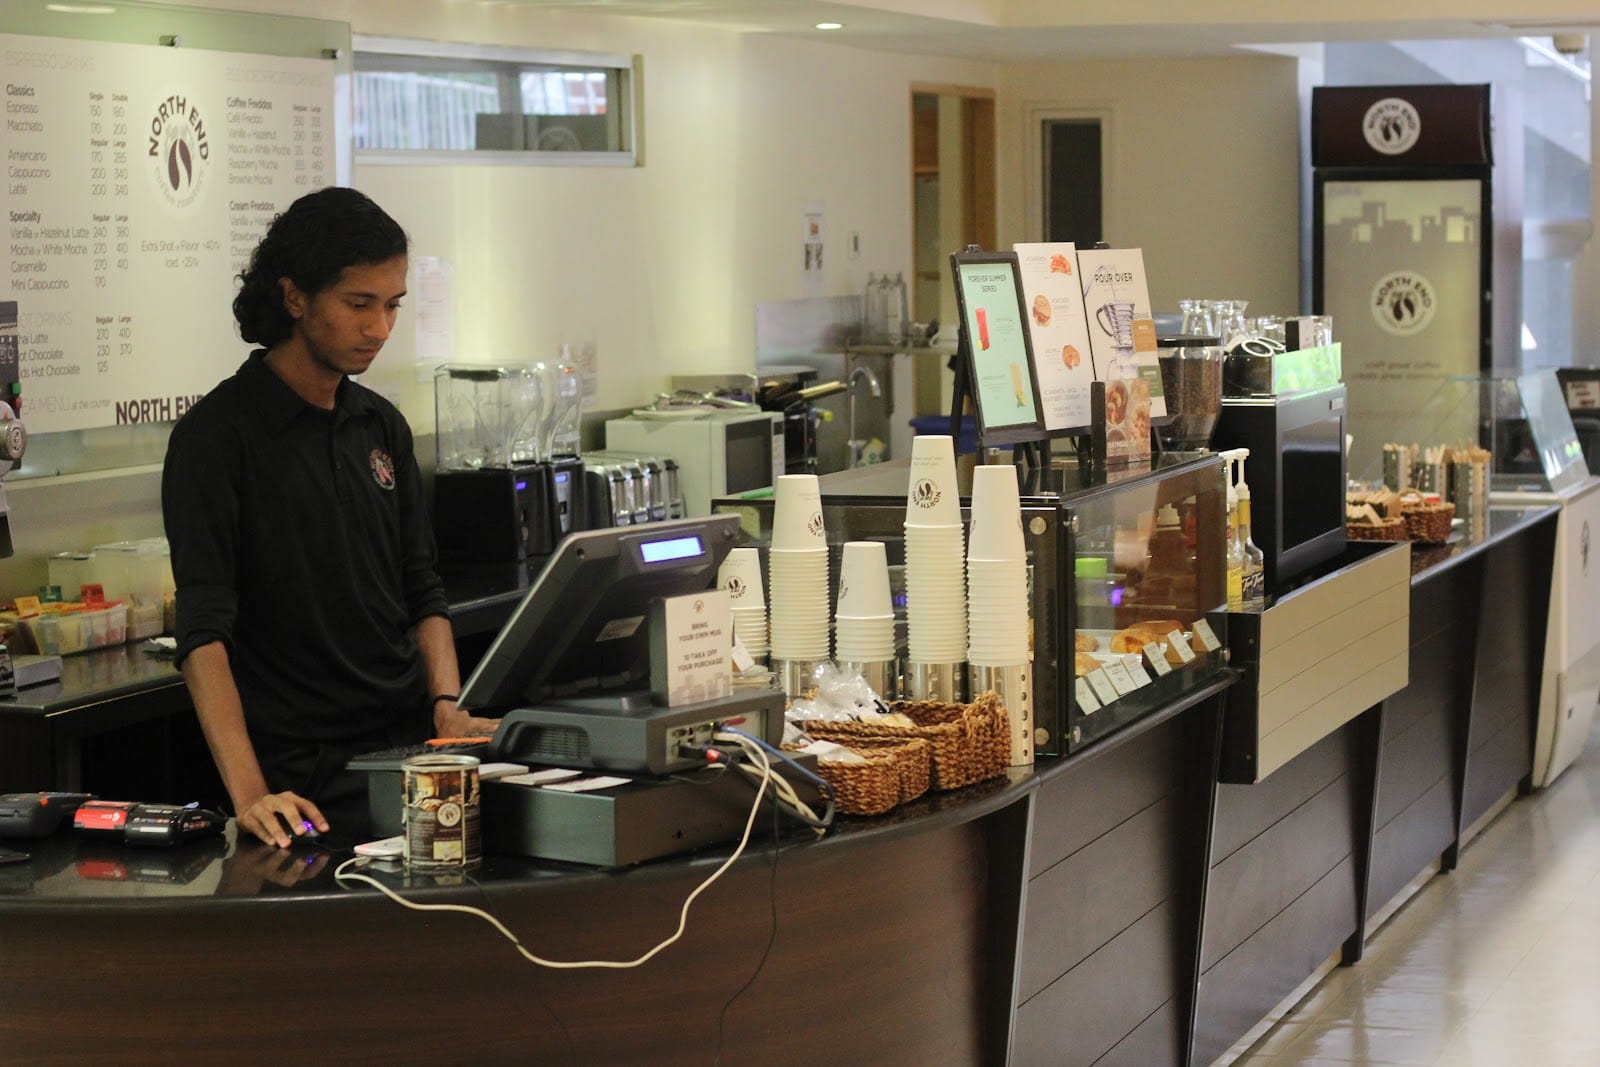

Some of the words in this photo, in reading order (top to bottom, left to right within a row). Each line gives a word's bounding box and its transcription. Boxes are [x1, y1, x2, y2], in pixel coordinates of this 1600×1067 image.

[6, 84, 35, 97] Classics
[7, 101, 39, 114] Espresso
[226, 97, 247, 109] Coffee
[248, 98, 273, 111] Freddos
[1368, 103, 1399, 129] NORTH
[1401, 107, 1417, 131] END
[7, 120, 43, 133] Macchiato
[148, 96, 187, 157] NORTH
[189, 106, 209, 160] END
[91, 138, 108, 148] Regular
[113, 139, 126, 149] Large
[8, 150, 47, 162] Americano
[8, 166, 51, 180] Cappuccino
[92, 168, 106, 180] 200
[114, 168, 128, 180] 340
[8, 183, 27, 196] Latte
[92, 184, 106, 196] 200
[114, 184, 128, 196] 340
[229, 200, 249, 212] Cream
[250, 200, 275, 212] Freddos
[9, 211, 41, 224] Specialty
[92, 214, 110, 223] Regular
[115, 214, 129, 223] Large
[10, 227, 33, 239] Vanilla
[40, 227, 70, 239] Hazelnut
[71, 226, 89, 239] Latte
[10, 243, 35, 256] Mocha
[42, 243, 63, 255] White
[64, 242, 88, 254] Mocha
[141, 240, 158, 252] Extra
[159, 240, 174, 252] Shot
[11, 279, 26, 291] Mini
[28, 277, 69, 291] Cappuccino
[967, 274, 988, 284] FOREVER
[989, 273, 1007, 282] SUMMER
[1094, 273, 1113, 284] POUR
[1114, 271, 1133, 283] OVER
[981, 285, 997, 293] SERIES
[1376, 276, 1412, 307] NORTH
[1414, 281, 1432, 308] END
[96, 316, 113, 324] Regular
[118, 315, 131, 324] Large
[31, 333, 48, 345] Latte
[96, 328, 109, 341] 270
[28, 347, 63, 361] Chocolate
[31, 365, 44, 377] Hot
[46, 364, 80, 377] Chocolate
[115, 397, 170, 425] NORTH
[920, 490, 942, 510] NORTH
[691, 621, 709, 631] BRING
[678, 634, 694, 643] YOUR
[695, 631, 709, 641] OWN
[709, 628, 722, 638] MUG
[691, 650, 706, 660] TAKA
[706, 647, 718, 657] OFF
[677, 662, 693, 673] YOUR
